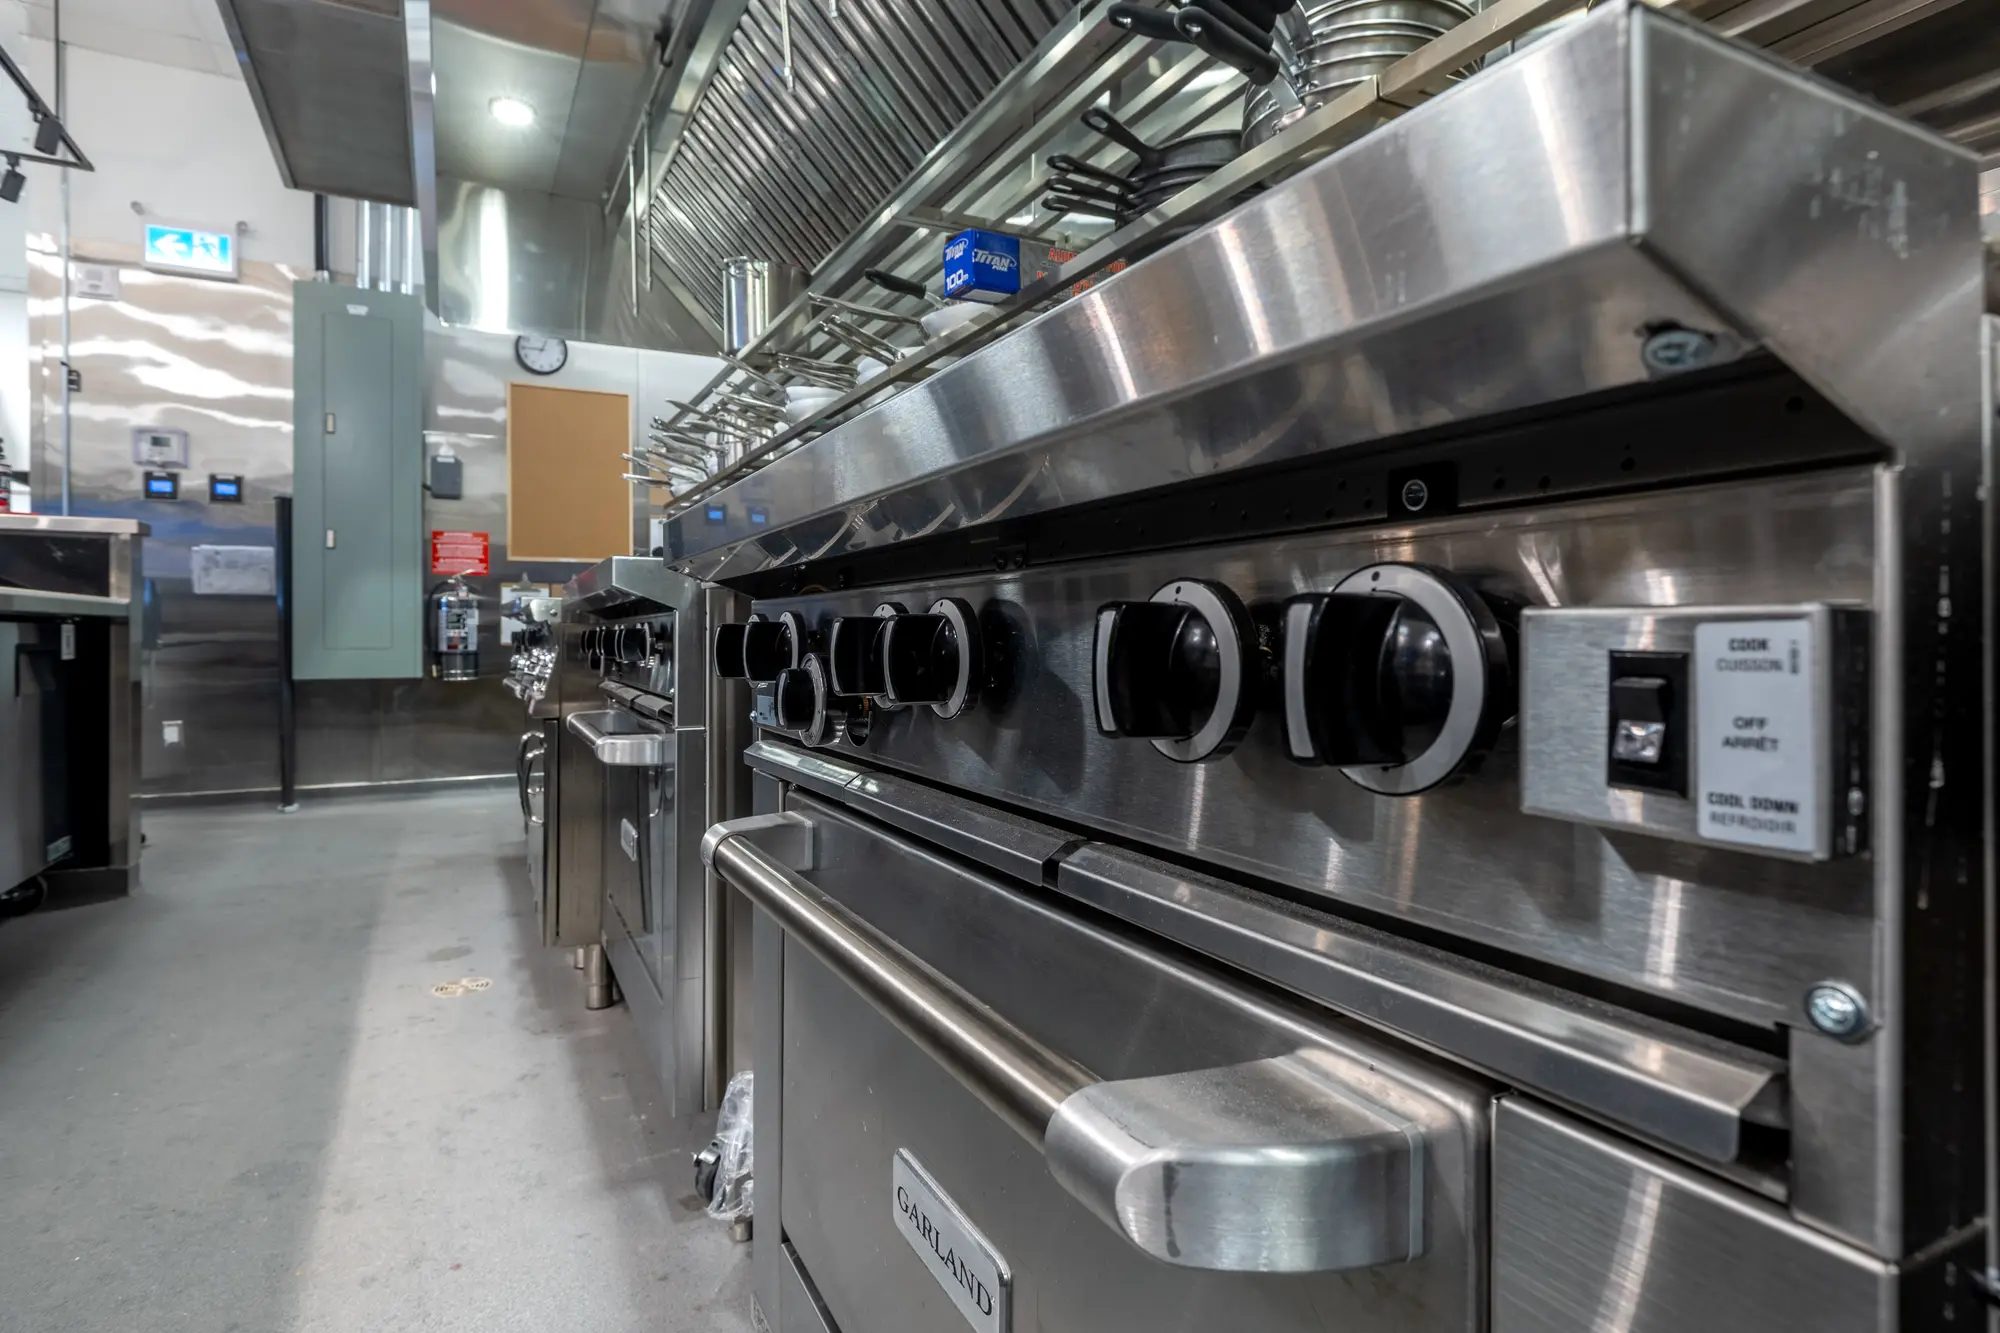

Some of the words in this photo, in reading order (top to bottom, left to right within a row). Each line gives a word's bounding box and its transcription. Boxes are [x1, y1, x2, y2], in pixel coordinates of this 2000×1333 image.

[945, 241, 965, 262] TITAN
[973, 248, 1011, 267] TITAN
[1728, 638, 1770, 652] COOK
[1716, 658, 1783, 672] CUISSON
[1732, 716, 1768, 730] OFF
[1707, 791, 1746, 809] COOL
[1749, 796, 1799, 814] DOWN
[897, 1186, 992, 1316] GARLAND
